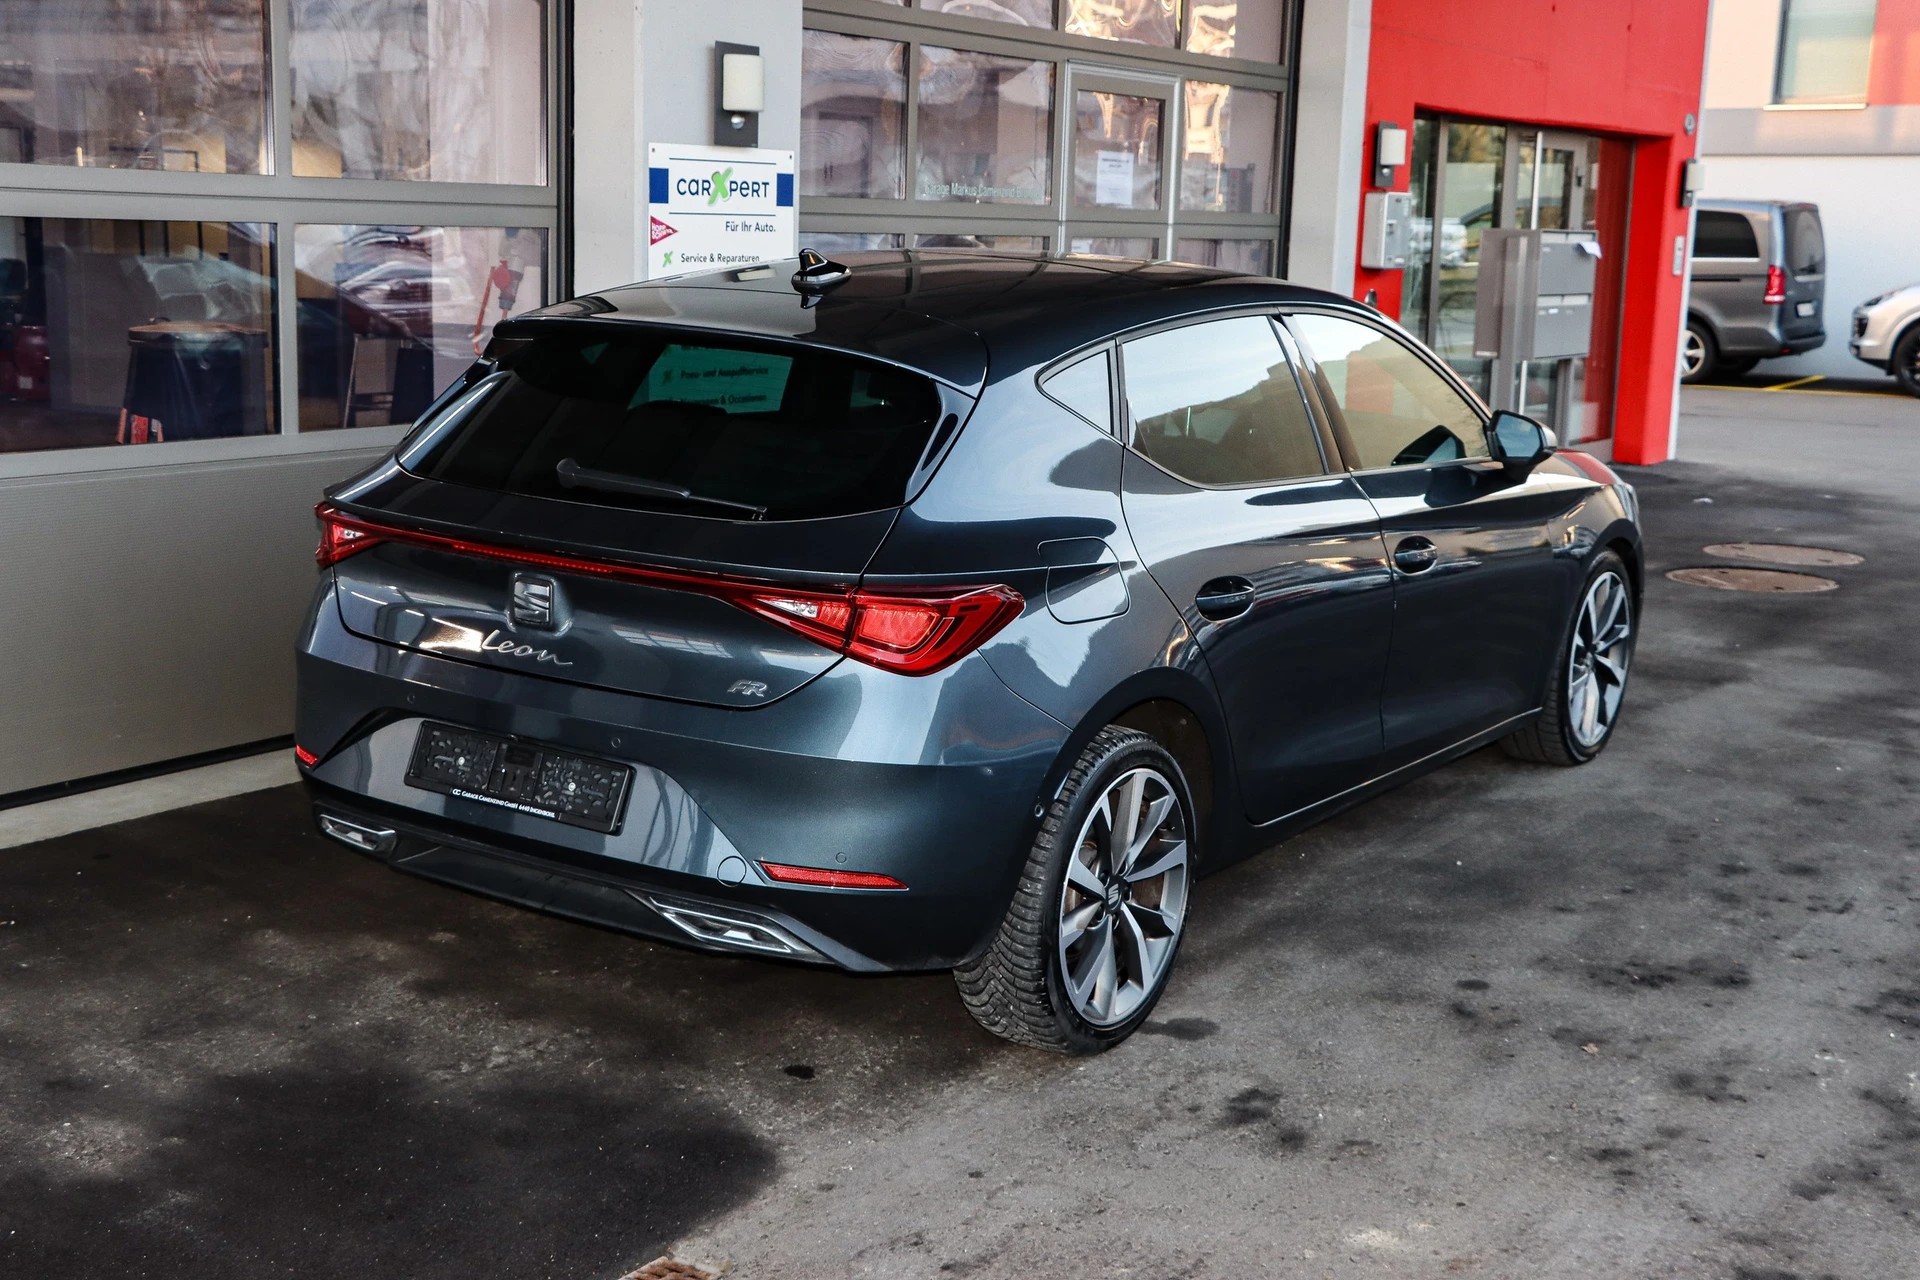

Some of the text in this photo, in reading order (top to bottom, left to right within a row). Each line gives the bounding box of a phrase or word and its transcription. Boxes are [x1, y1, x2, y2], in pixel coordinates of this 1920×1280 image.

[725, 221, 776, 233] Für Ihr Auto.
[681, 253, 760, 265] Service & Reparaturen
[727, 679, 768, 698] FR
